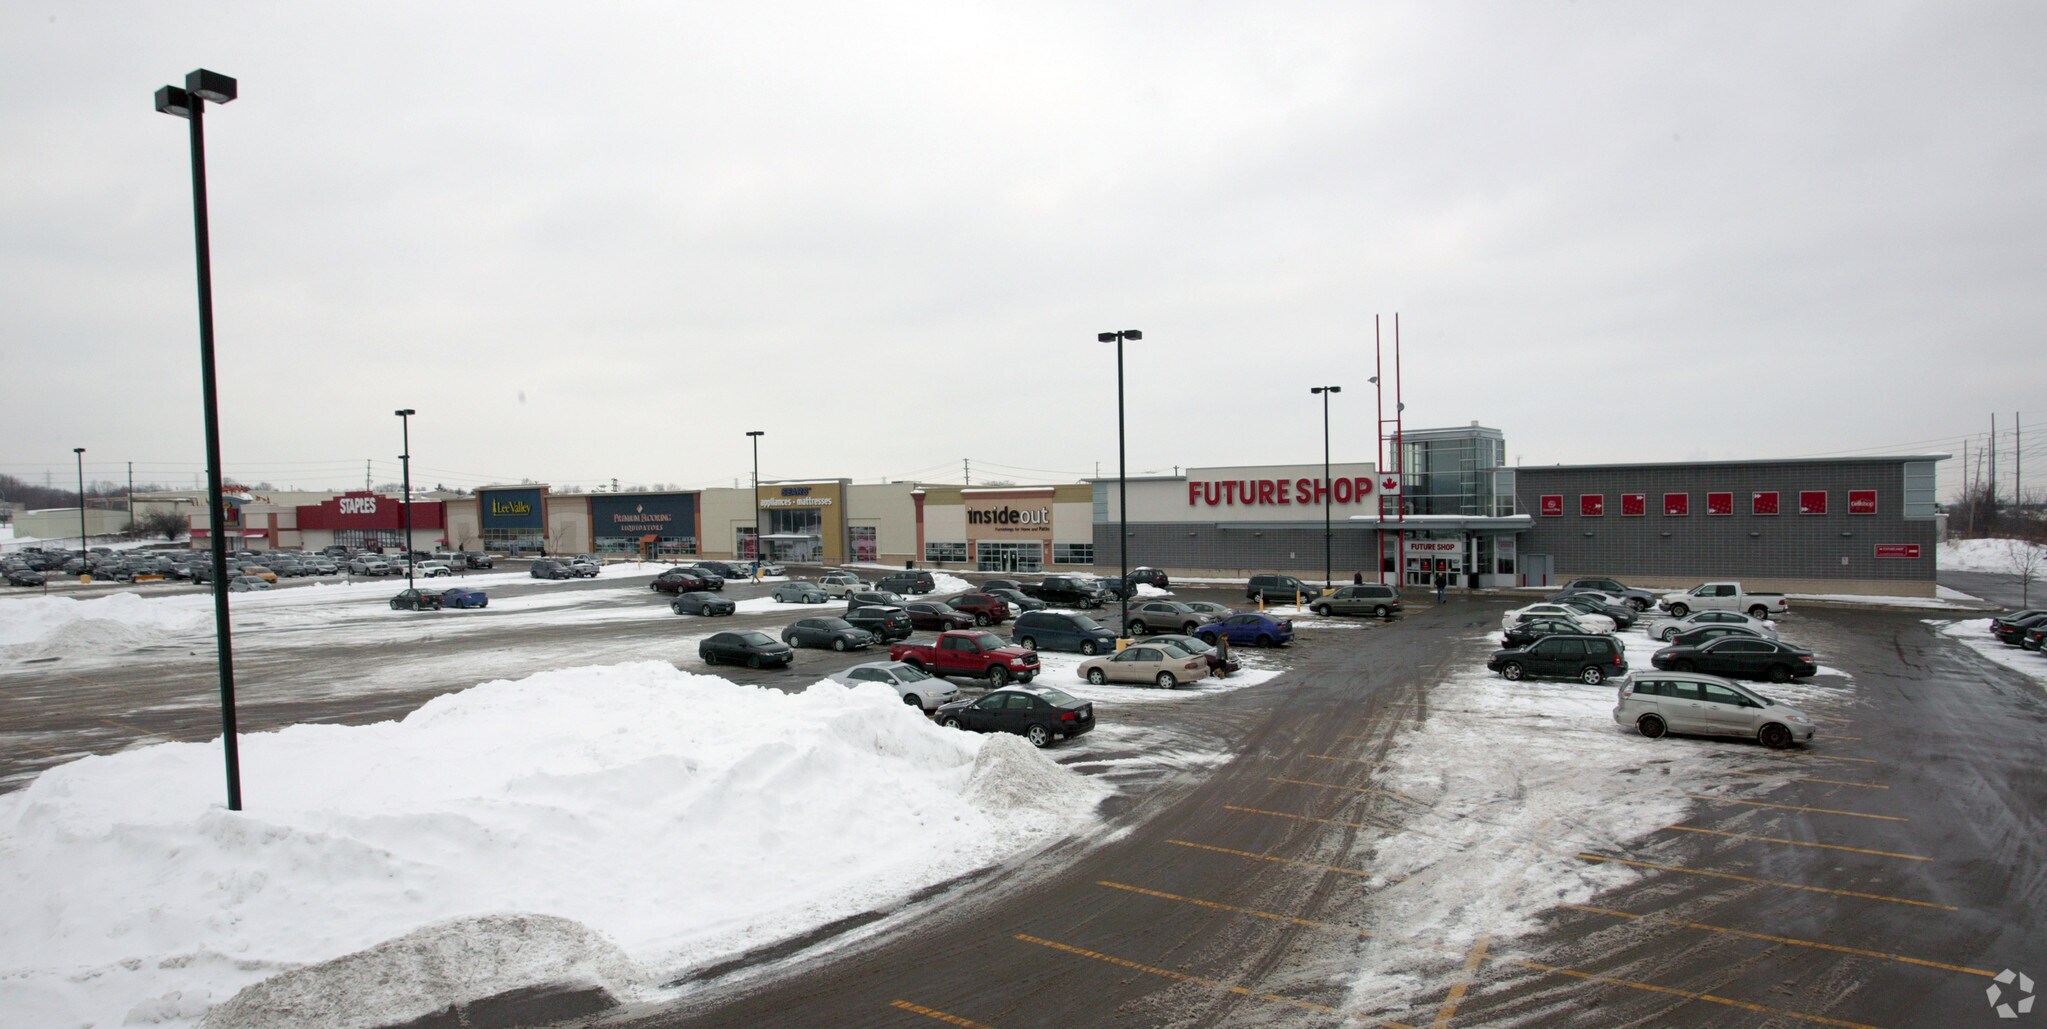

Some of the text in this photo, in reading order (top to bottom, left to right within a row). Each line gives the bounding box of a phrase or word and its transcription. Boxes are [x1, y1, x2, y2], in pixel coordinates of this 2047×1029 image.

[781, 487, 809, 496] SEARS
[1189, 477, 1373, 506] FUTURE SHOP
[340, 498, 376, 514] STAPLES
[497, 501, 531, 513] Lee Valley
[760, 497, 832, 508] appliances mattresses
[967, 506, 1049, 525] insideout
[621, 524, 664, 532] LIQUIDATORS
